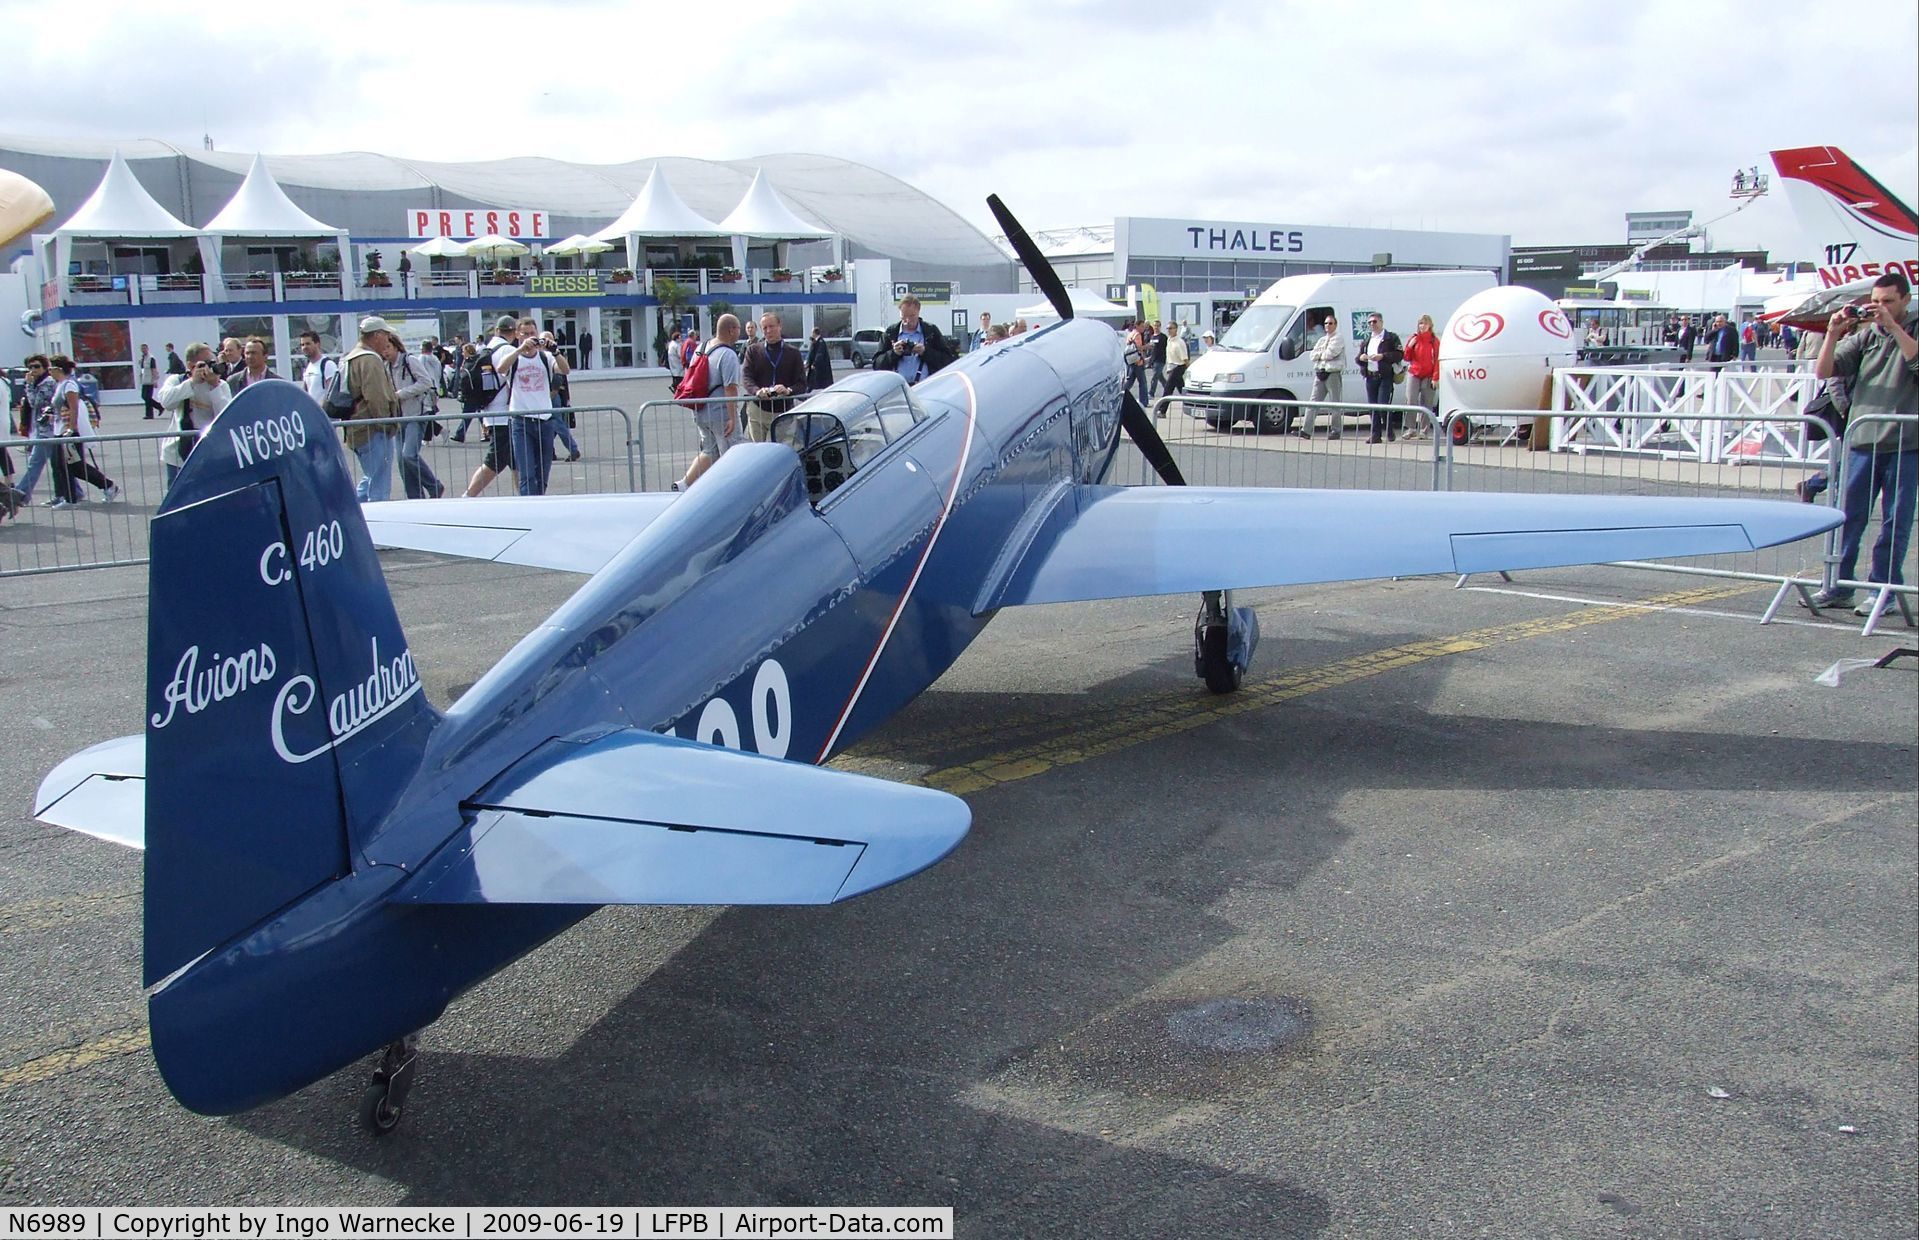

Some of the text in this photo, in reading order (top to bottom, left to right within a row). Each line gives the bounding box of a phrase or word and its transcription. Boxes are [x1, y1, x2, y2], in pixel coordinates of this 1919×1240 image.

[417, 212, 542, 236] PRESSE
[1187, 227, 1303, 252] THALES
[1825, 243, 1858, 265] 117
[531, 277, 599, 292] PRESSE
[1454, 368, 1487, 380] MIKO
[260, 520, 343, 586] C. 460
[151, 643, 277, 728] Avions
[271, 636, 422, 764] Caudron
